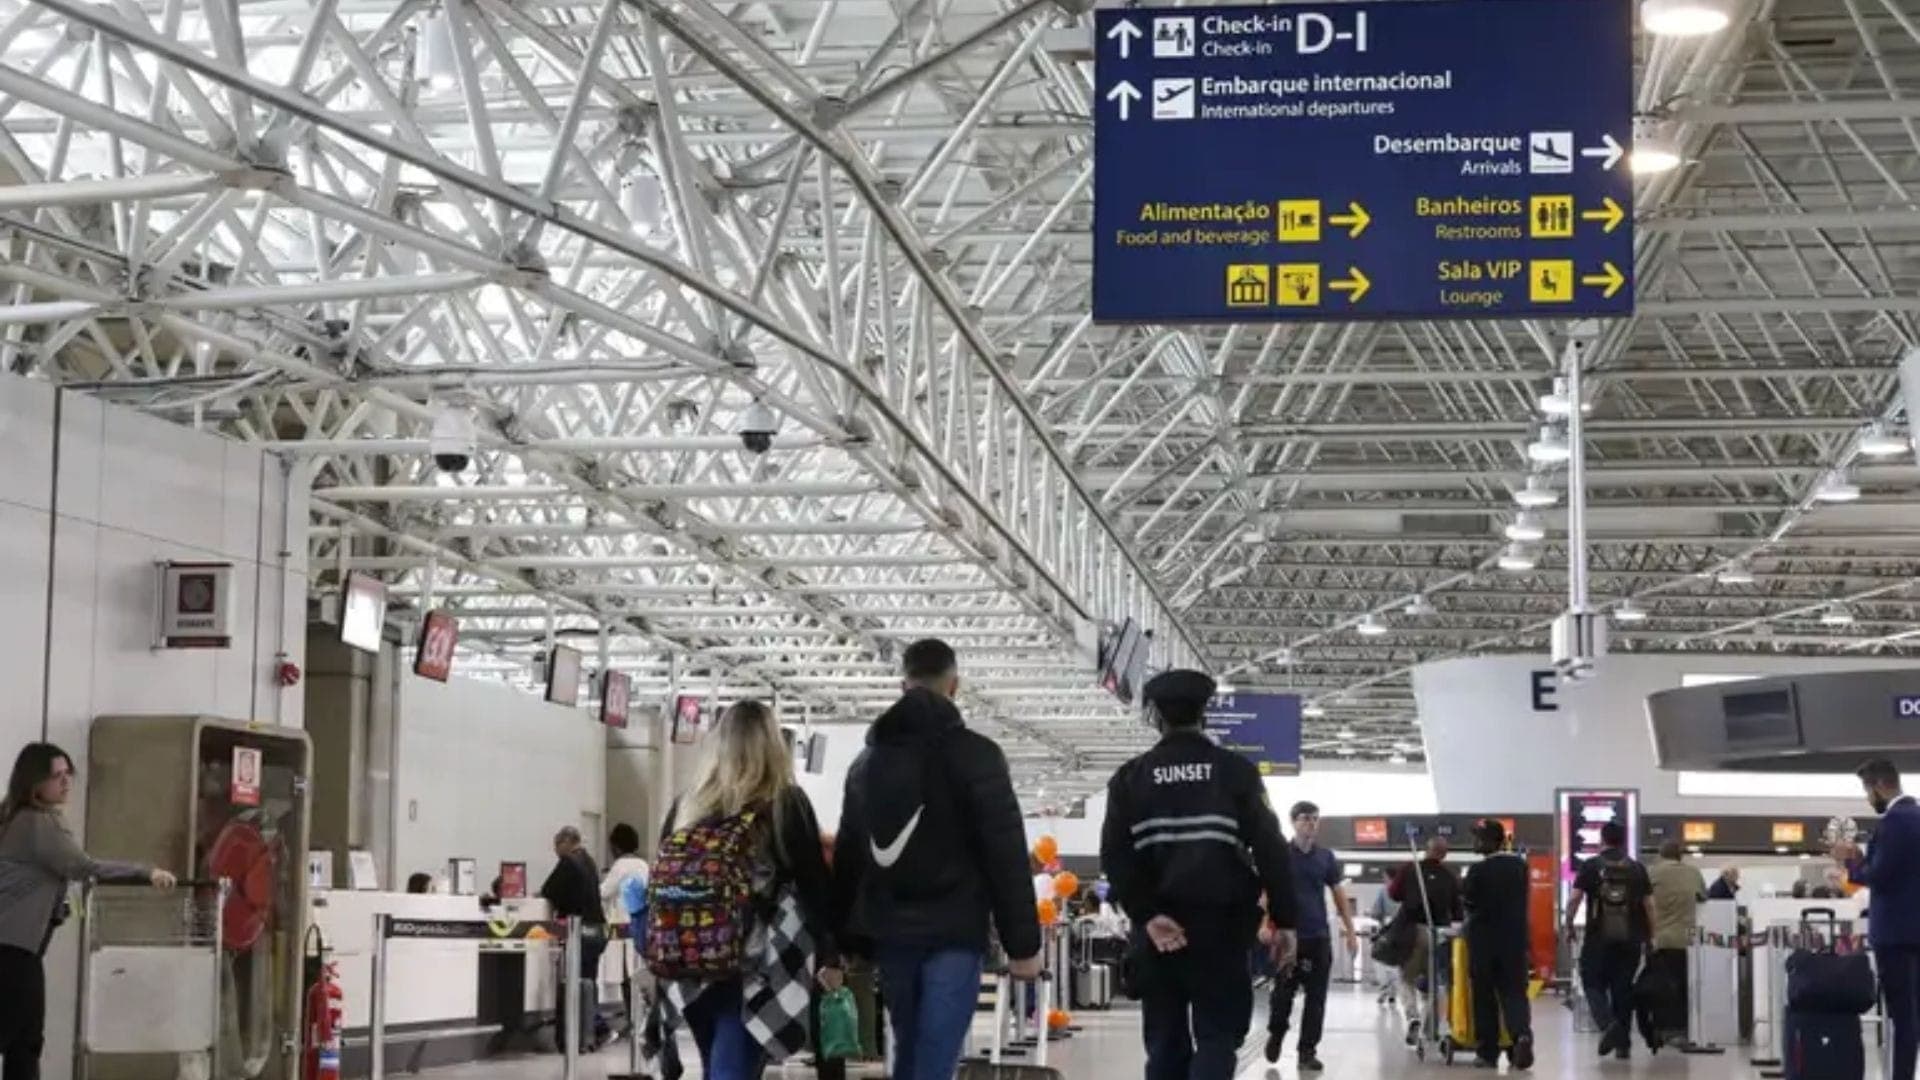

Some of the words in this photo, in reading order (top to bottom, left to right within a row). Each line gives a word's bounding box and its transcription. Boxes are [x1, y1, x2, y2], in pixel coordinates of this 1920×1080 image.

[1201, 14, 1292, 35] Check-in
[1297, 10, 1367, 55] D-I
[1201, 39, 1273, 56] Check-in
[1201, 76, 1310, 98] Embarque
[1313, 70, 1452, 92] internacional
[1201, 101, 1305, 119] International
[1307, 100, 1395, 119] departures
[1373, 133, 1523, 156] Desembarque
[1460, 159, 1522, 176] Arrivals
[1140, 201, 1271, 224] Alimentação
[1416, 197, 1522, 216] Banheiros
[1116, 230, 1158, 246] Food
[1160, 229, 1191, 245] and
[1193, 229, 1271, 247] beverage
[1435, 223, 1522, 240] Restrooms
[1438, 261, 1482, 280] Sala
[1485, 260, 1522, 280] VIP
[1440, 289, 1504, 308] Lounge
[1531, 671, 1558, 711] E
[1153, 763, 1212, 785] SUNSET
